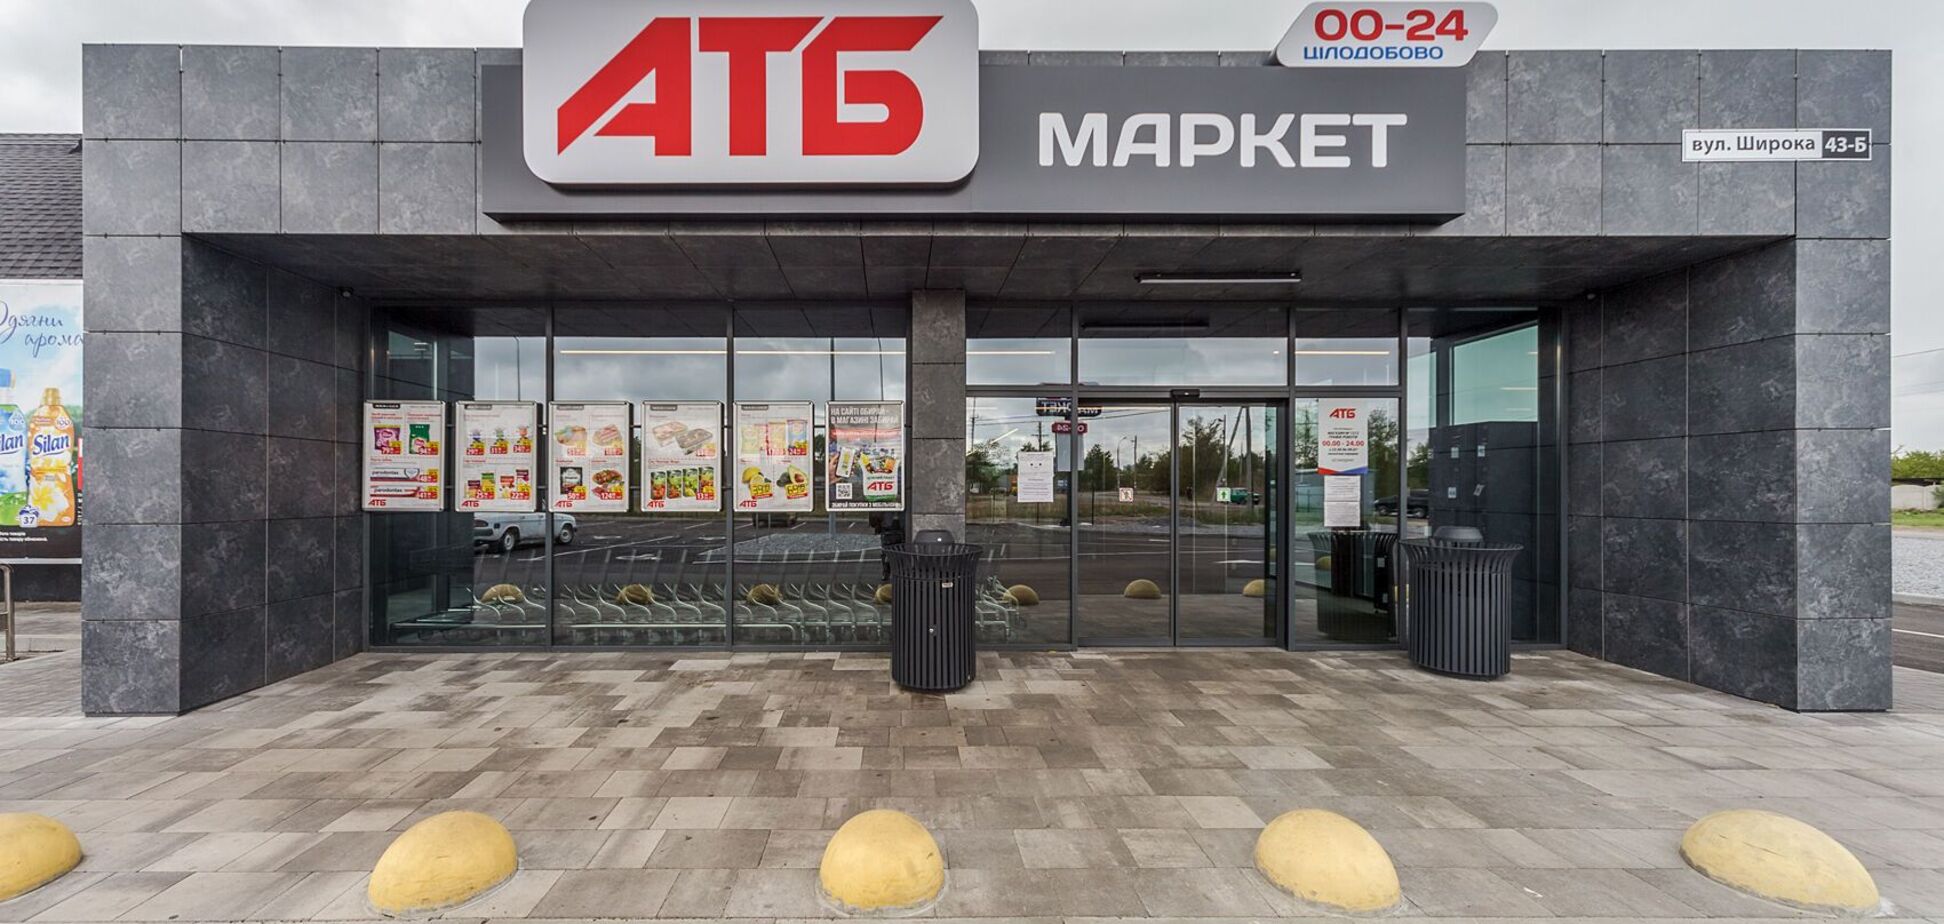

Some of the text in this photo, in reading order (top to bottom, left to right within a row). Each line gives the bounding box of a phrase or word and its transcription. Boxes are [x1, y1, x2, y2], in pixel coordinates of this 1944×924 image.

[1314, 9, 1469, 41] 00-24
[1303, 46, 1443, 60] ЦІЛОДОБОВО
[557, 15, 944, 157] АТБ
[1038, 112, 1408, 168] МАРКЕТ
[1692, 136, 1867, 155] вул. Широка 43-Б
[1329, 408, 1356, 419] АТБ
[0, 433, 24, 451] lan
[33, 434, 70, 456] Silan
[868, 481, 893, 490] АТБ
[23, 516, 35, 525] 37
